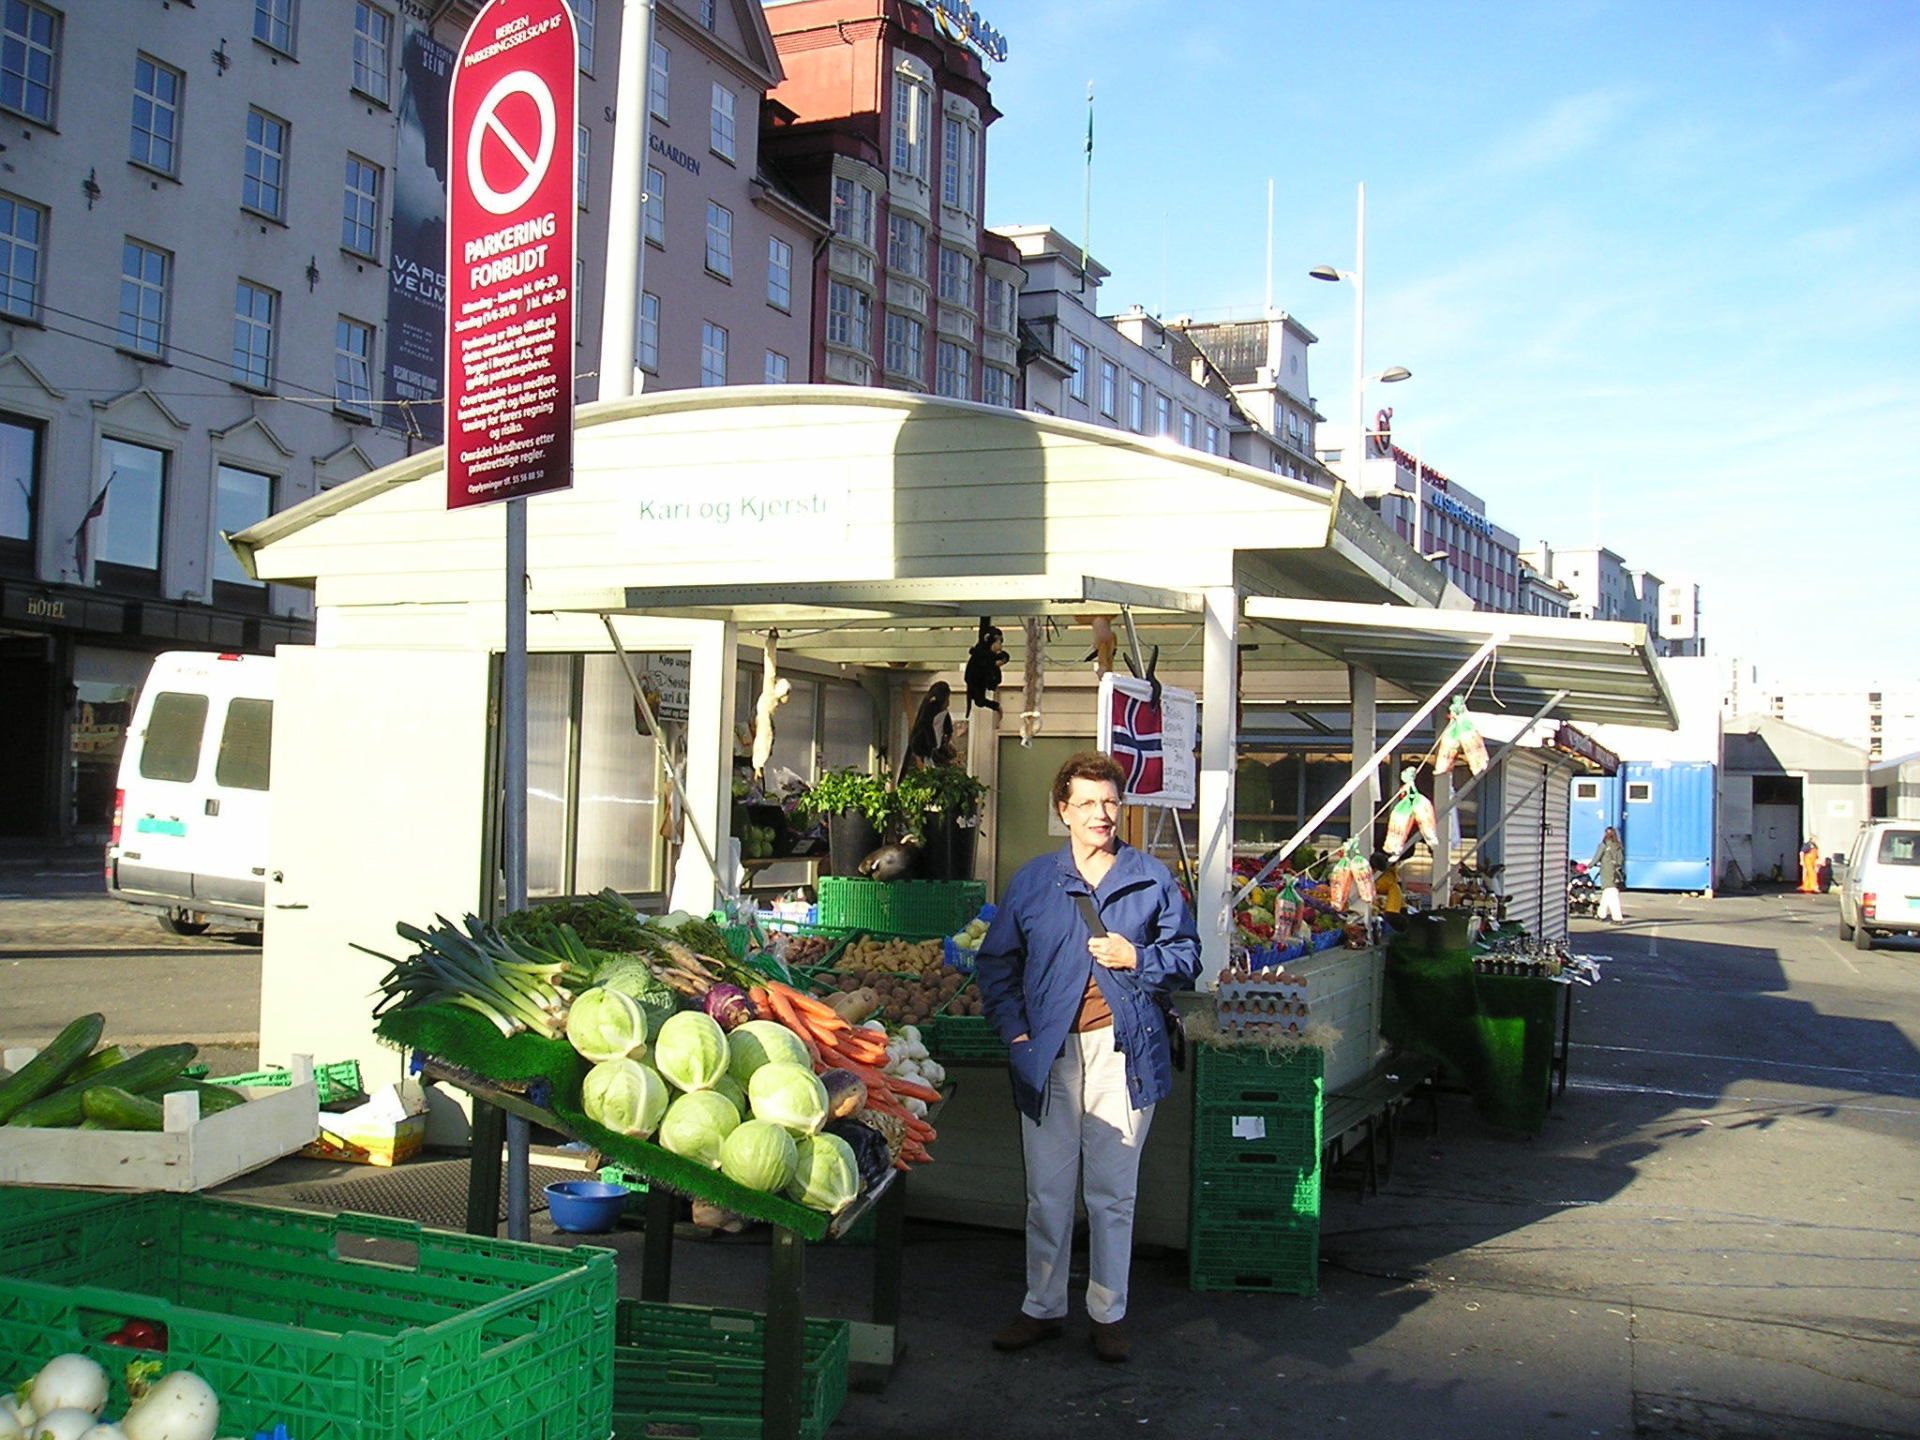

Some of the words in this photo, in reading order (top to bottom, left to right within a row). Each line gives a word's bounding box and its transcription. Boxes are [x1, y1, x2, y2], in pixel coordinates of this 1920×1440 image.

[464, 20, 549, 68] PARKERINGSSELSKAP
[550, 13, 562, 29] KF
[496, 15, 529, 40] BERGEN
[464, 212, 556, 264] PARKERING
[471, 244, 548, 290] FORBUDT
[462, 297, 493, 314] Mandag
[533, 274, 558, 291] 06-20
[542, 288, 567, 305] 06-20
[462, 333, 496, 351] Parkering
[497, 330, 506, 340] er
[506, 325, 522, 338] ikke
[523, 318, 545, 333] tillatt
[545, 312, 556, 328] på
[464, 360, 489, 376] Torget
[492, 353, 520, 367] Bergen
[534, 344, 553, 356] uten
[507, 383, 522, 394] kan
[538, 387, 559, 400] bort-
[487, 414, 500, 426] for
[523, 401, 554, 418] regning
[489, 428, 500, 440] og
[460, 446, 492, 463] Området
[535, 433, 555, 446] etter
[520, 449, 546, 464] regler.
[640, 500, 690, 520] Kari
[699, 501, 731, 523] og
[741, 494, 827, 522] Kjersti
[28, 597, 65, 618] HOTEL
